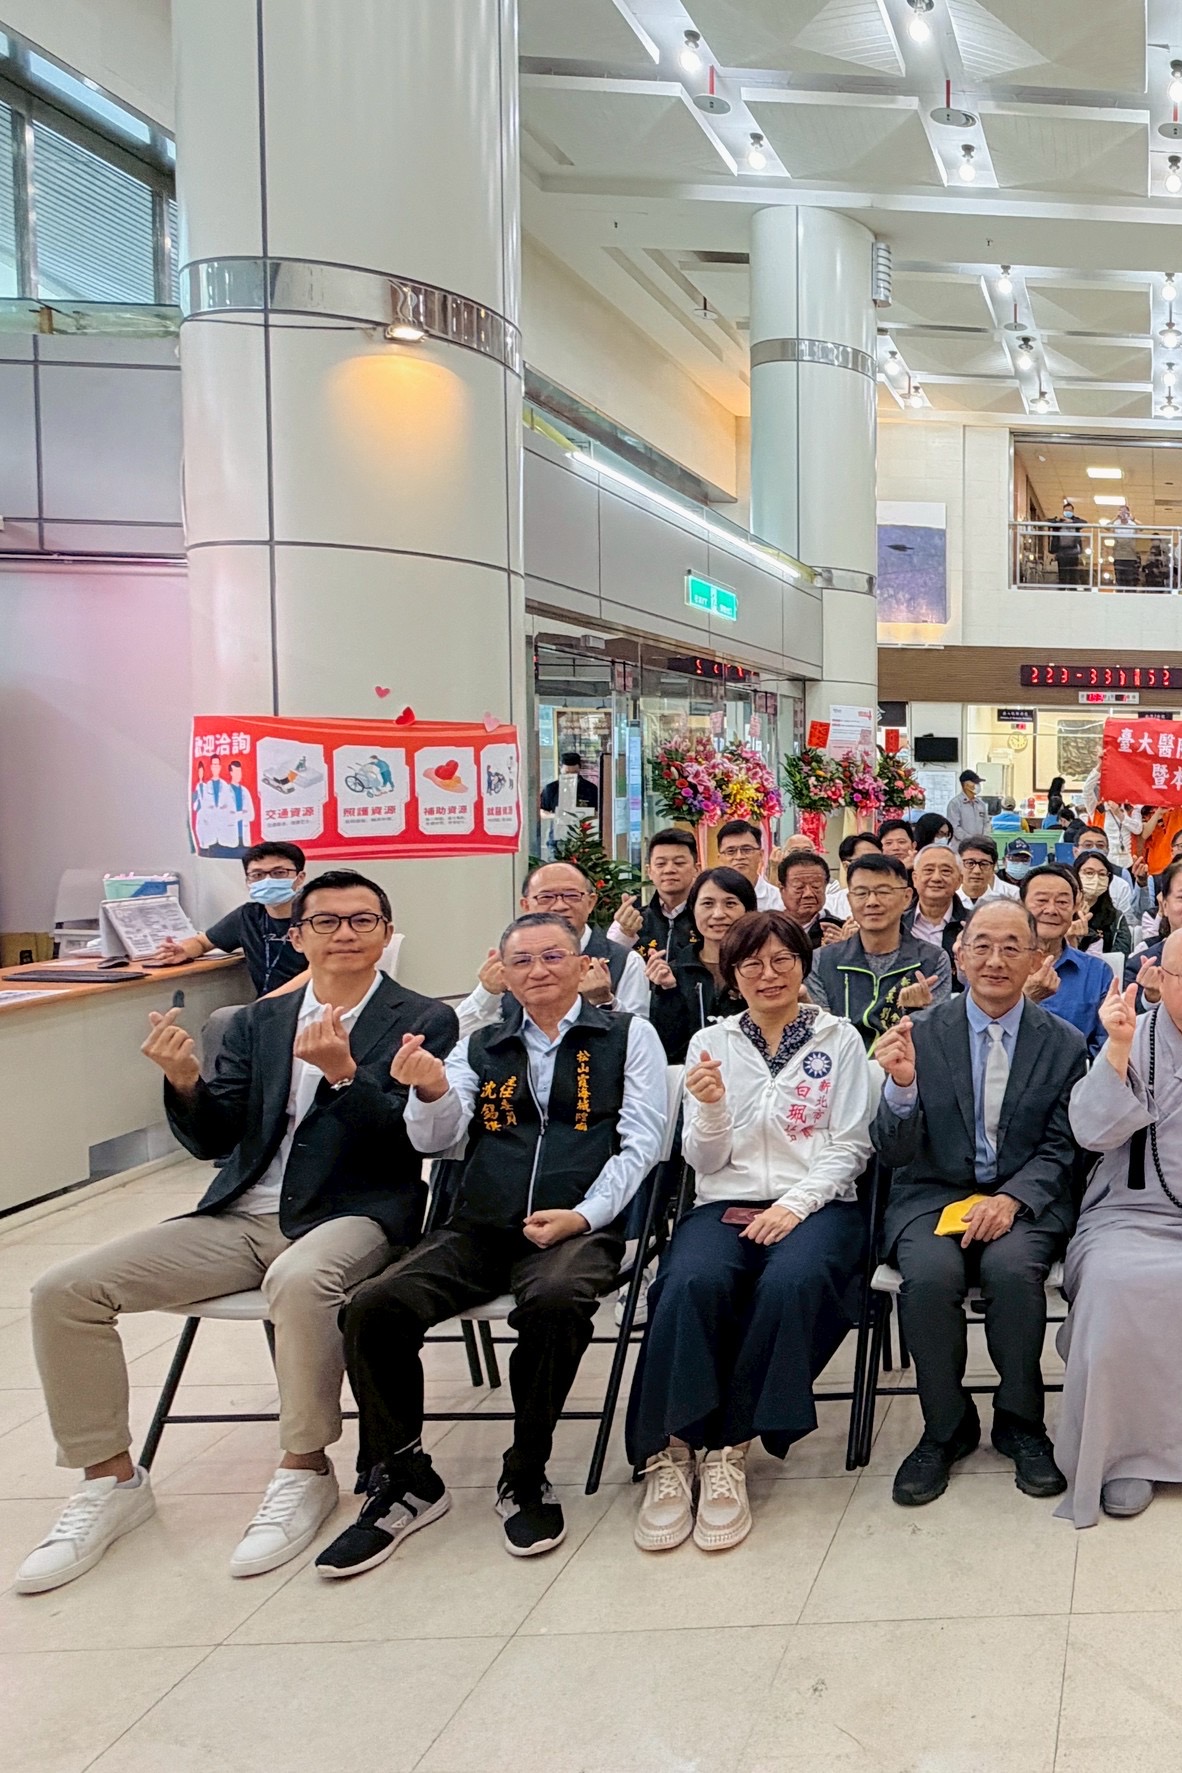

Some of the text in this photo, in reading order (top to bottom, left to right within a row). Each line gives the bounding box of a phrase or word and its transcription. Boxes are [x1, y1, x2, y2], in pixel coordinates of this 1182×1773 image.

[265, 806, 314, 820] 交通資源
[343, 805, 396, 817] 照護資源
[424, 805, 468, 816] 補助資源
